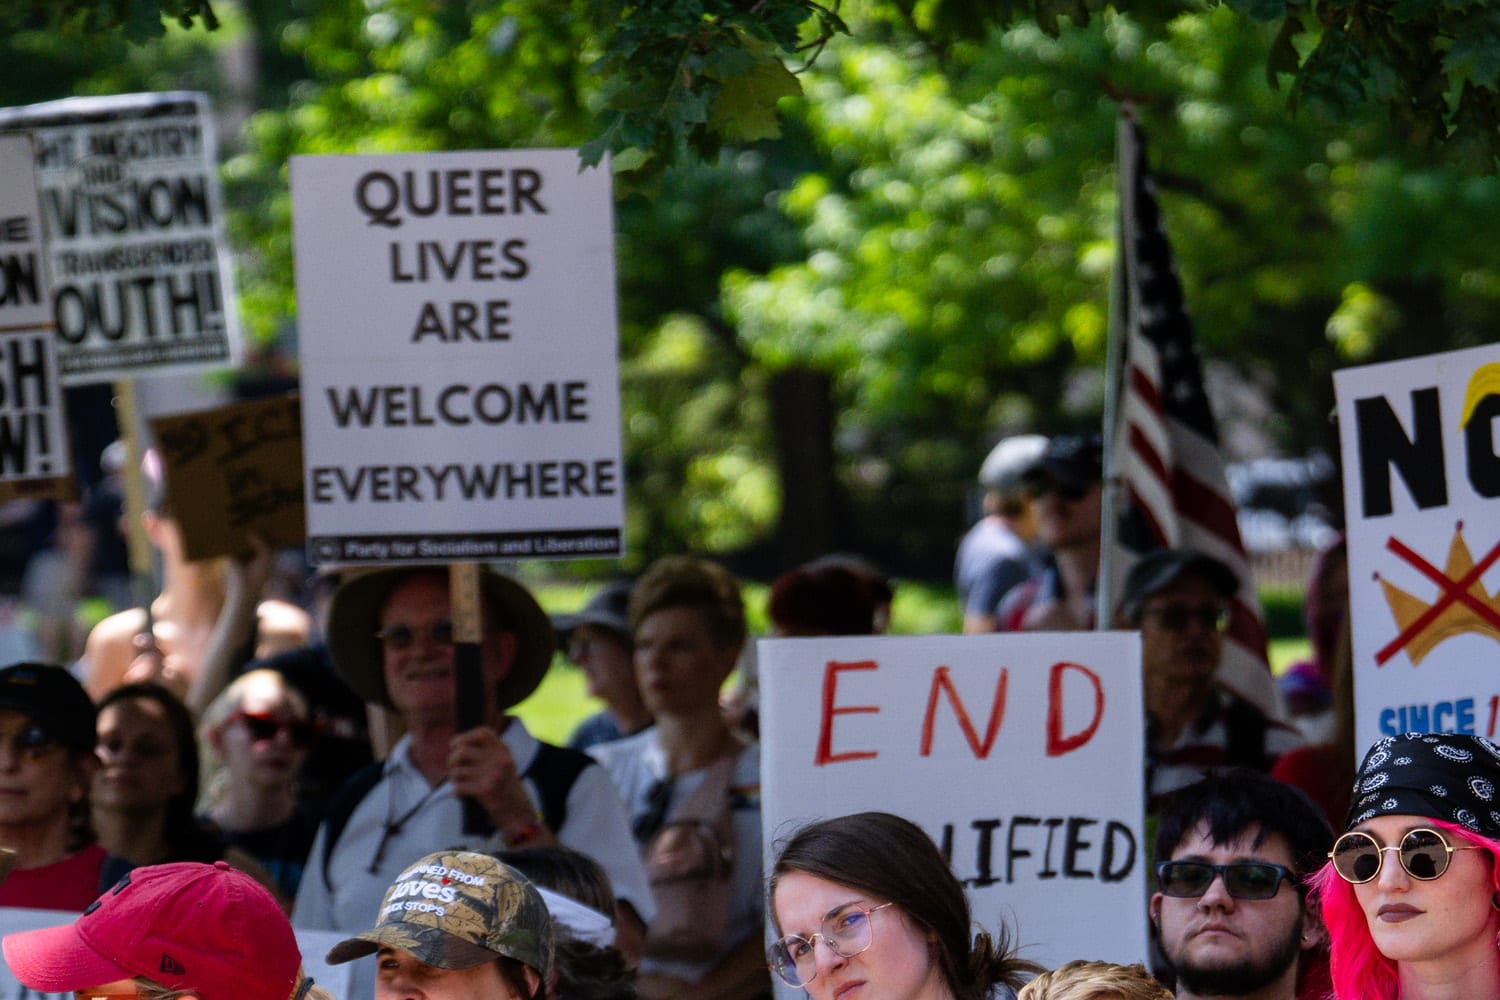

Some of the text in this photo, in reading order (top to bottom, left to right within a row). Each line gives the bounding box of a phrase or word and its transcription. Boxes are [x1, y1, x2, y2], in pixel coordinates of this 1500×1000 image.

[355, 168, 547, 228] QUEER
[389, 239, 530, 283] LIVES
[411, 300, 511, 343] ARE
[326, 380, 589, 428] WELCOME
[311, 458, 616, 503] EVERYWHERE
[345, 535, 617, 559] Party for Socialism and Liberation
[813, 660, 1105, 766] END
[1379, 697, 1476, 735] SINCE
[449, 868, 486, 887] FROM
